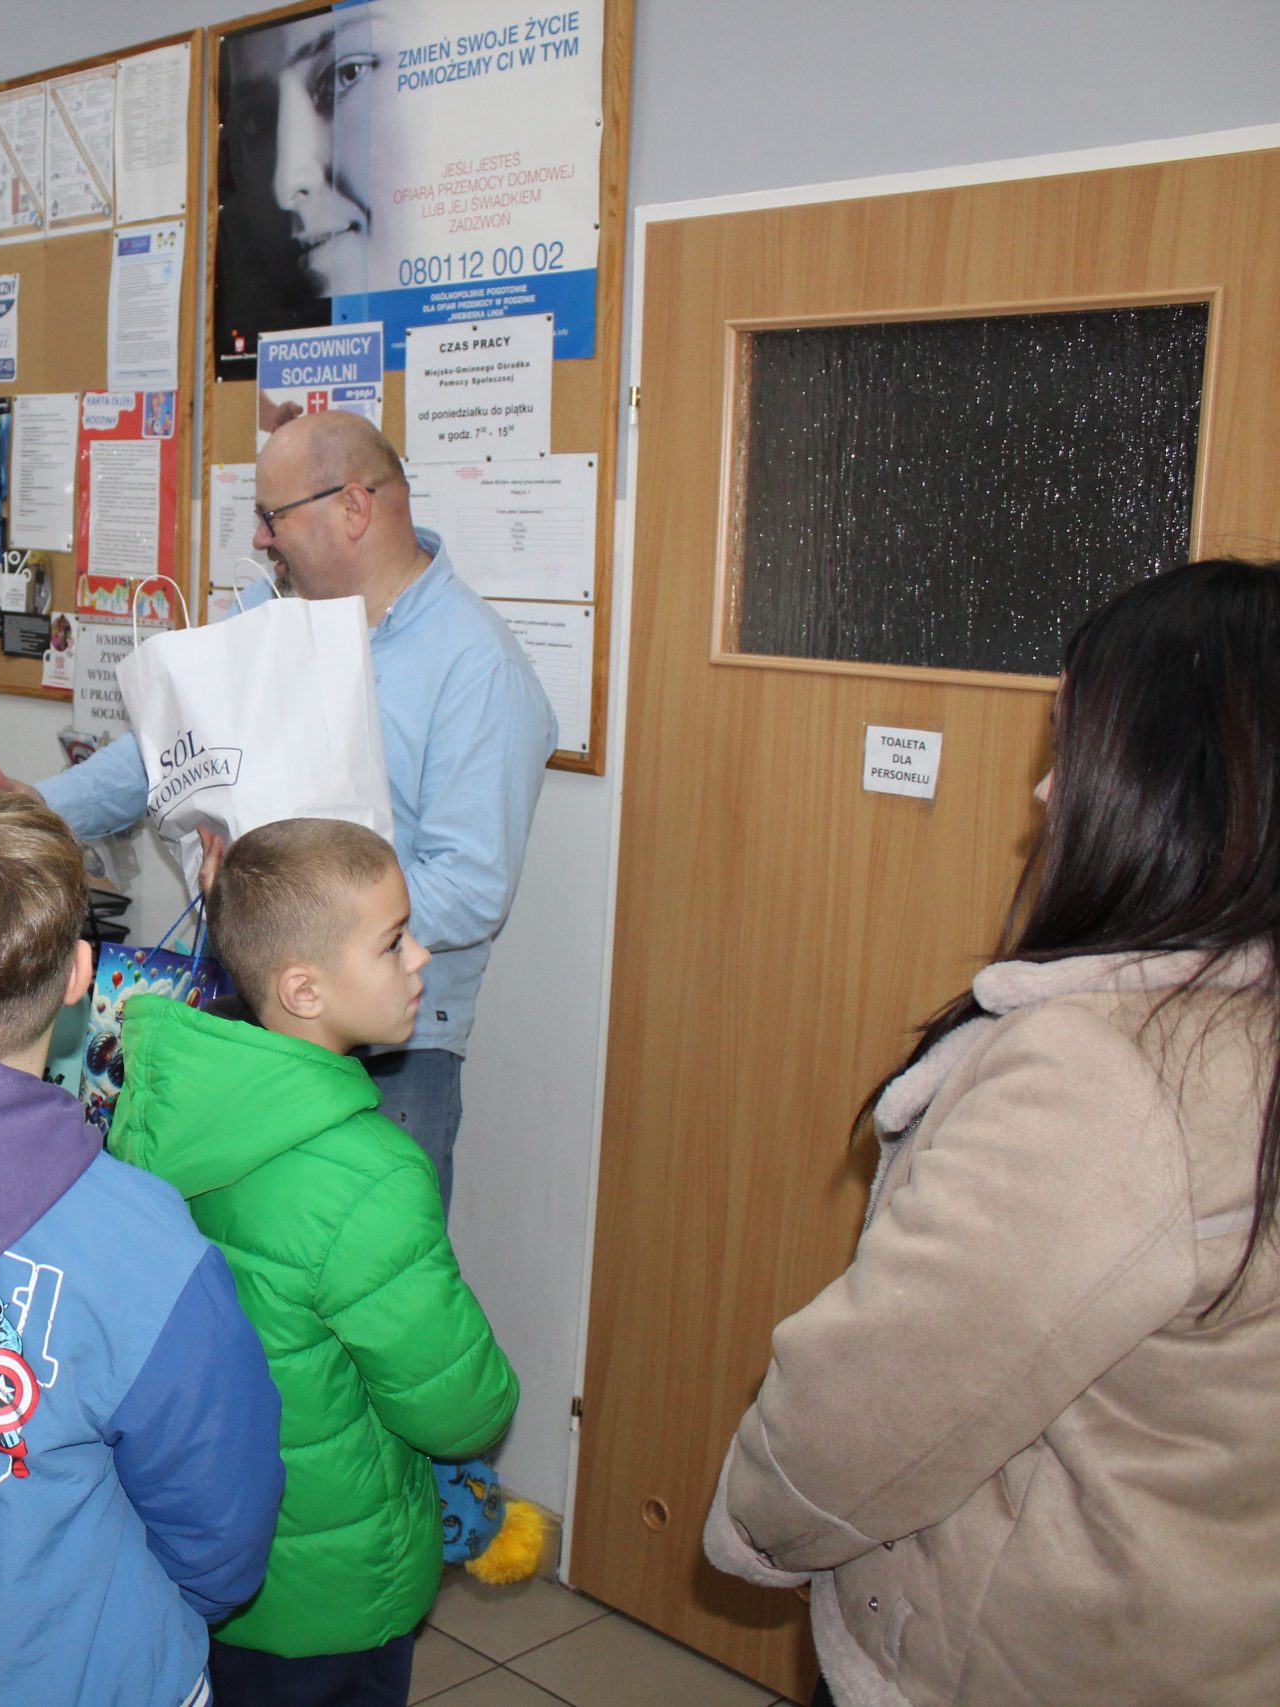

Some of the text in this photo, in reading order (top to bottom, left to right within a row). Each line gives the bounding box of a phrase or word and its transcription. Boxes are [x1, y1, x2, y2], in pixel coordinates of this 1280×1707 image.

[398, 11, 580, 69] ZMIEŃ SWOJE ŻYCIE
[398, 37, 580, 92] POMOŻEMY CI W TYM
[393, 164, 576, 205] OFIARĄ PRZEMOCY DOMOWEJ
[422, 202, 445, 218] LUB
[448, 198, 468, 215] JEJ
[493, 246, 524, 276] 00
[533, 241, 564, 272] 02
[486, 284, 528, 296] POGOTOWIE
[269, 336, 371, 361] PRACOWNICY
[439, 336, 510, 353] CZAS PRACY
[282, 364, 357, 385] SOCJALNI
[439, 379, 469, 388] Pomocy
[418, 403, 533, 421] od poniedziałku do piątku
[438, 432, 446, 440] w
[448, 430, 472, 442] godz.
[2, 549, 32, 583] 1%
[96, 634, 135, 646] WNIOSK
[87, 669, 117, 682] WYDA
[81, 688, 122, 702] U PRACO
[91, 707, 130, 721] SOCJAL
[880, 736, 926, 750] TOALETA
[160, 730, 205, 779] SÓL
[891, 754, 912, 765] DLA
[871, 767, 930, 784] PERSONELU
[148, 757, 230, 817] KŁODAWSKA
